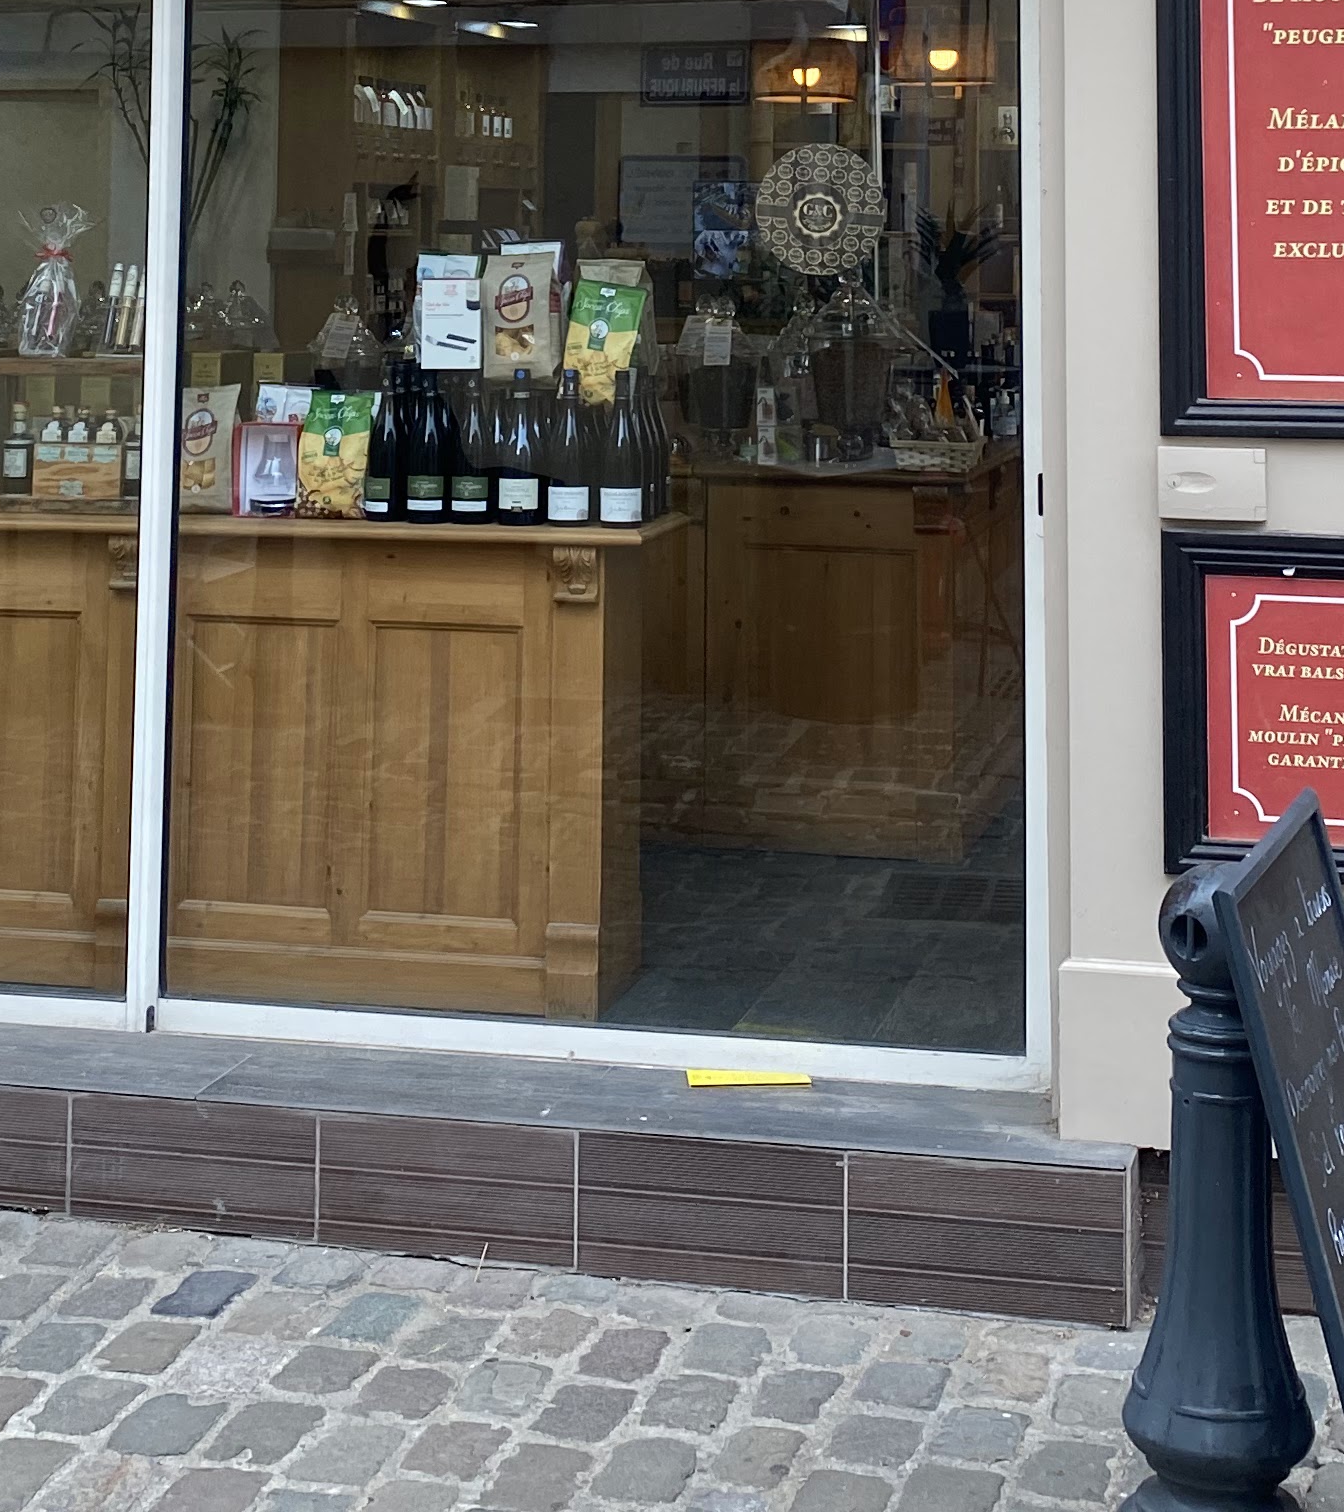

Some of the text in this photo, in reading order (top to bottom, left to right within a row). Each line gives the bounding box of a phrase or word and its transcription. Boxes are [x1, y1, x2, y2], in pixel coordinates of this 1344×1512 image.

[1265, 199, 1296, 215] ET
[1301, 199, 1333, 215] DE
[1251, 663, 1296, 678] VRAI
[1247, 730, 1320, 746] MOULIN
